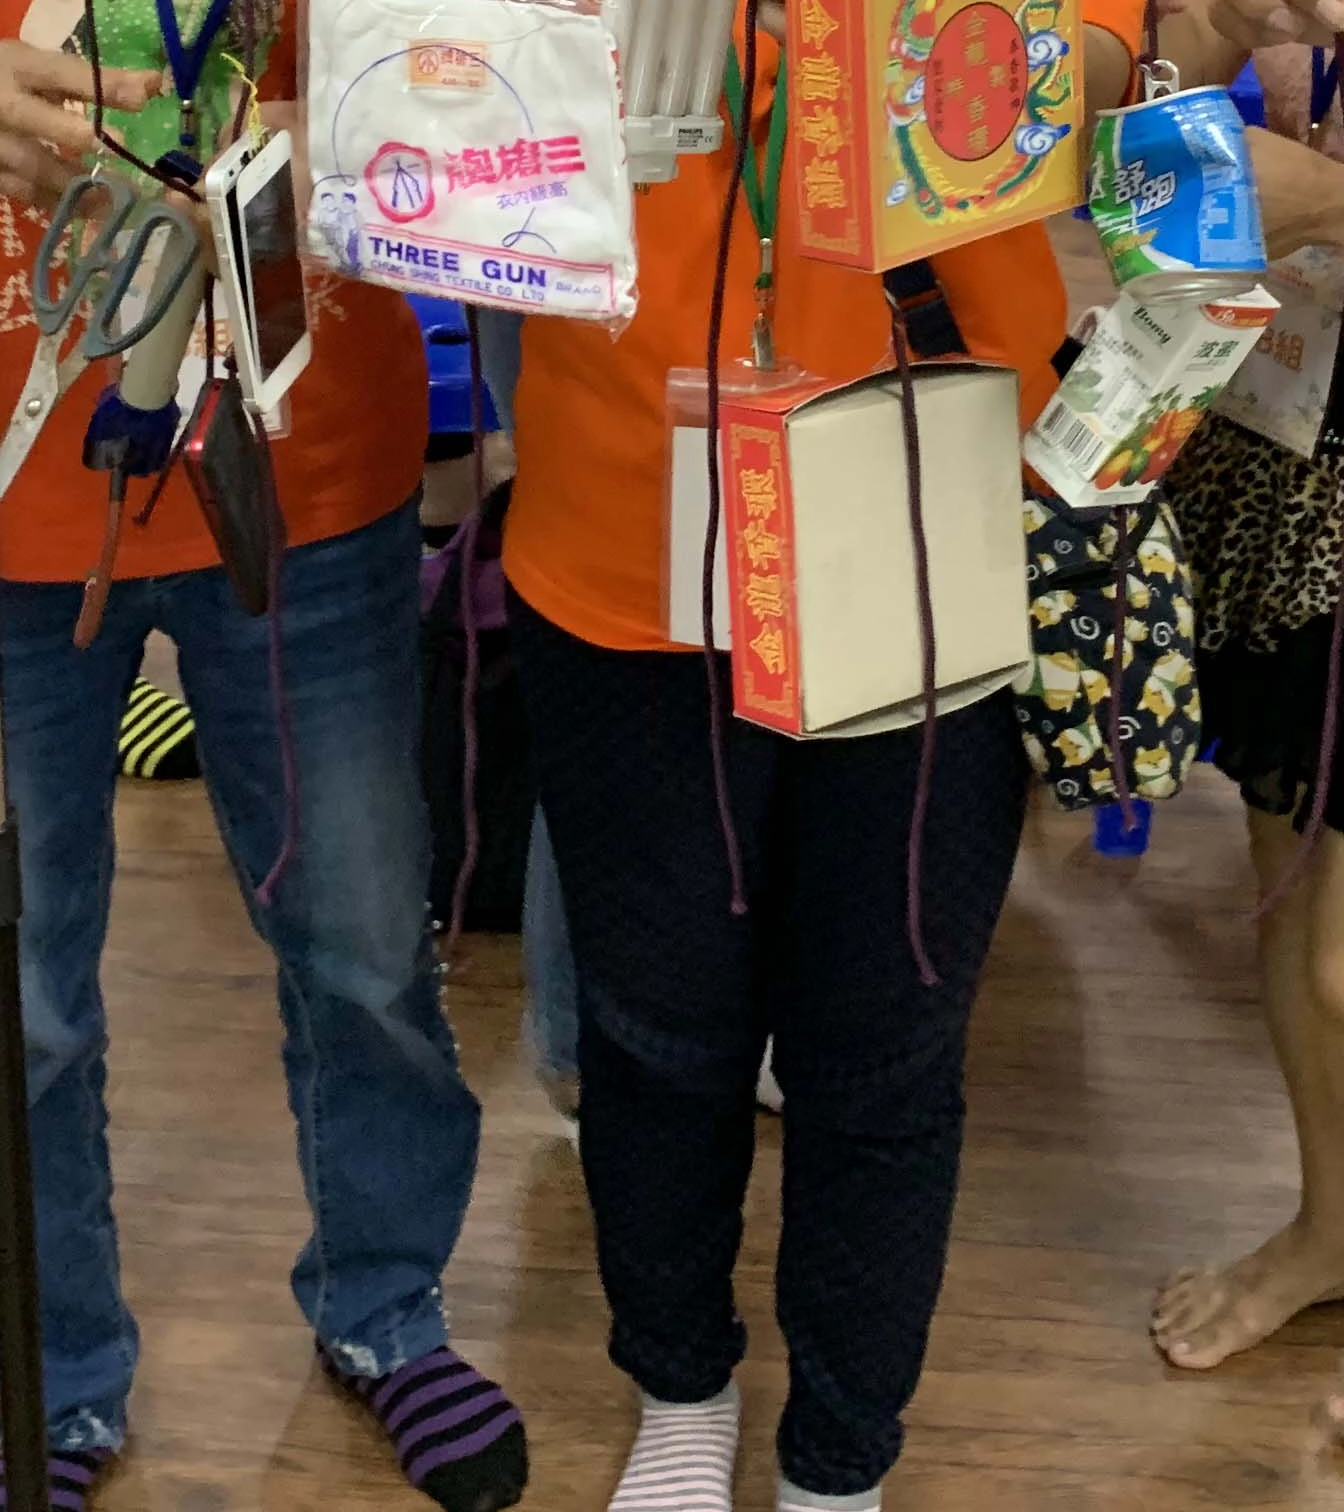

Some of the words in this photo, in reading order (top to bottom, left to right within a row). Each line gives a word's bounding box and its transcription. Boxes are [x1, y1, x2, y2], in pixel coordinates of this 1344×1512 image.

[368, 236, 460, 272] THREE
[482, 259, 547, 288] GUN
[445, 274, 492, 296] TEXTILE
[1133, 305, 1172, 345] Bomy
